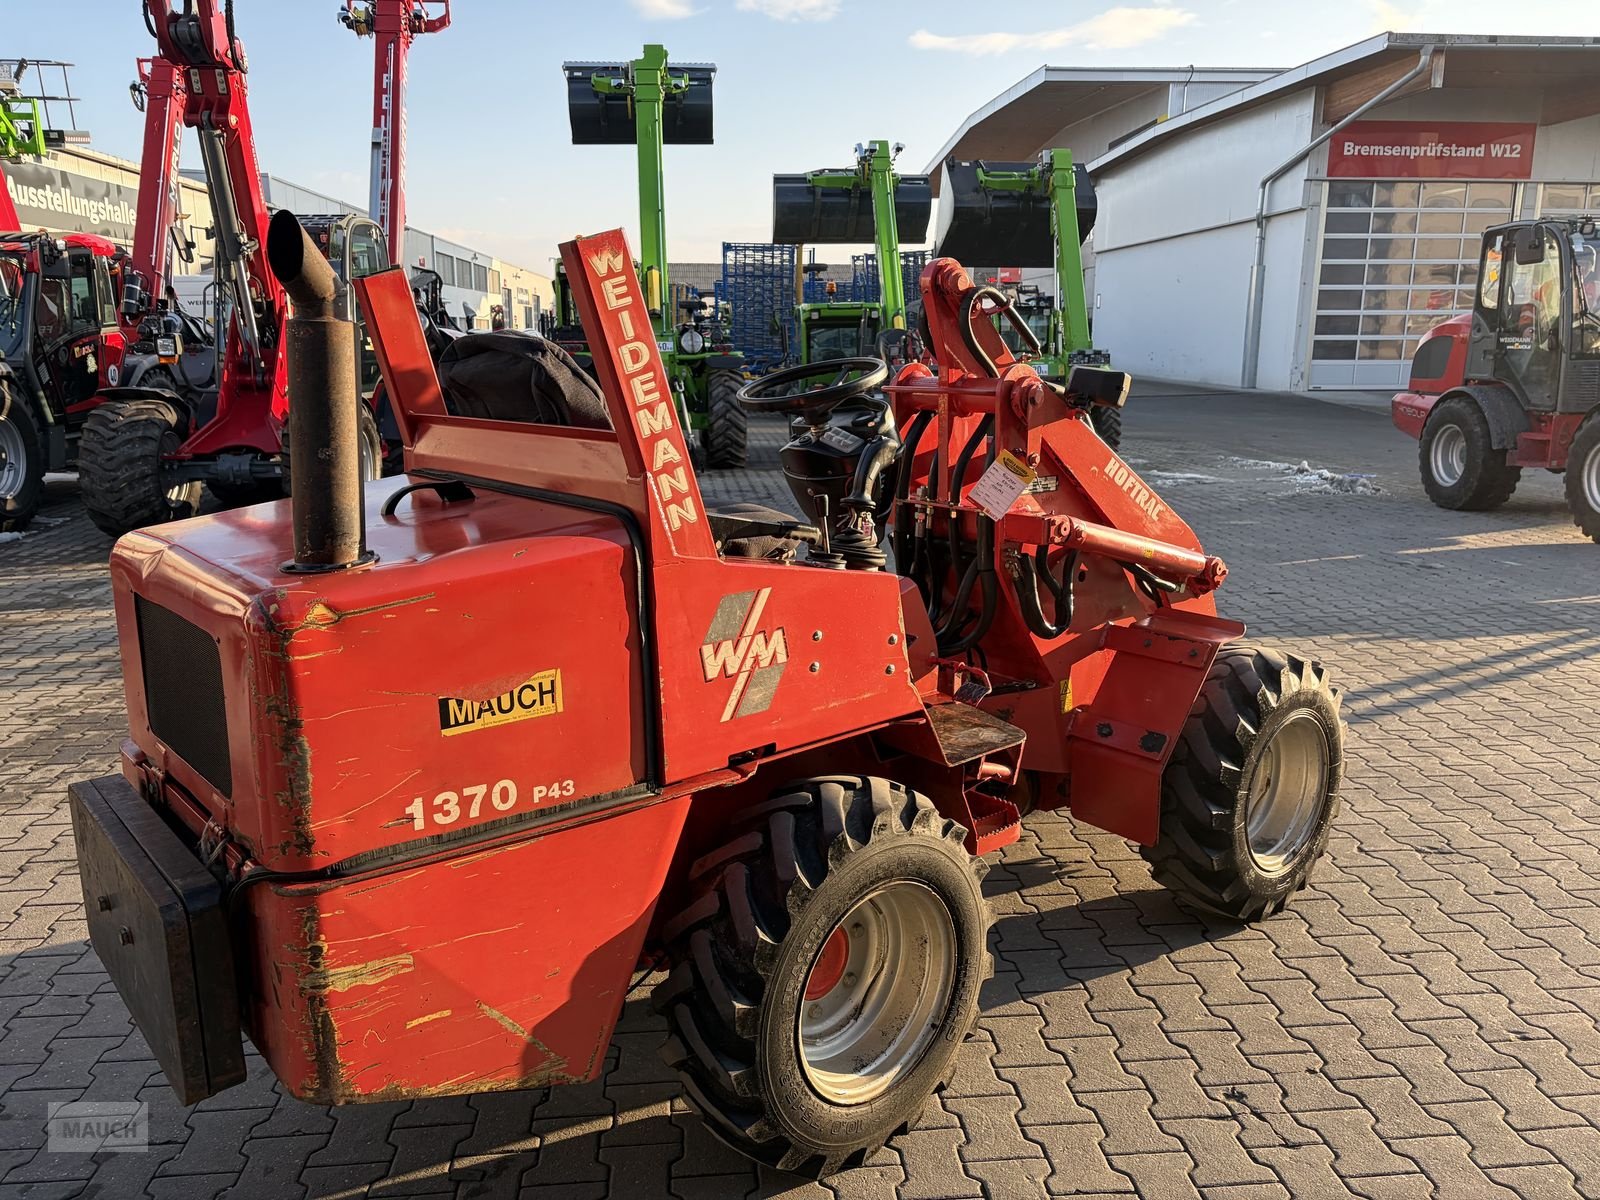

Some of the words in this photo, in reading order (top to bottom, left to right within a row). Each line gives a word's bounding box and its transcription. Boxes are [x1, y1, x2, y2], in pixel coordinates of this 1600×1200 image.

[169, 124, 181, 201] MERLO
[1343, 141, 1485, 160] Bremsenprüfstand
[1490, 143, 1521, 158] W12
[7, 175, 136, 224] Ausstellungshalle
[587, 250, 698, 532] WEIDEMANN
[1104, 457, 1166, 521] HOFTRAC
[448, 680, 555, 726] MAUCH
[405, 779, 518, 831] 1370
[533, 780, 576, 803] P43
